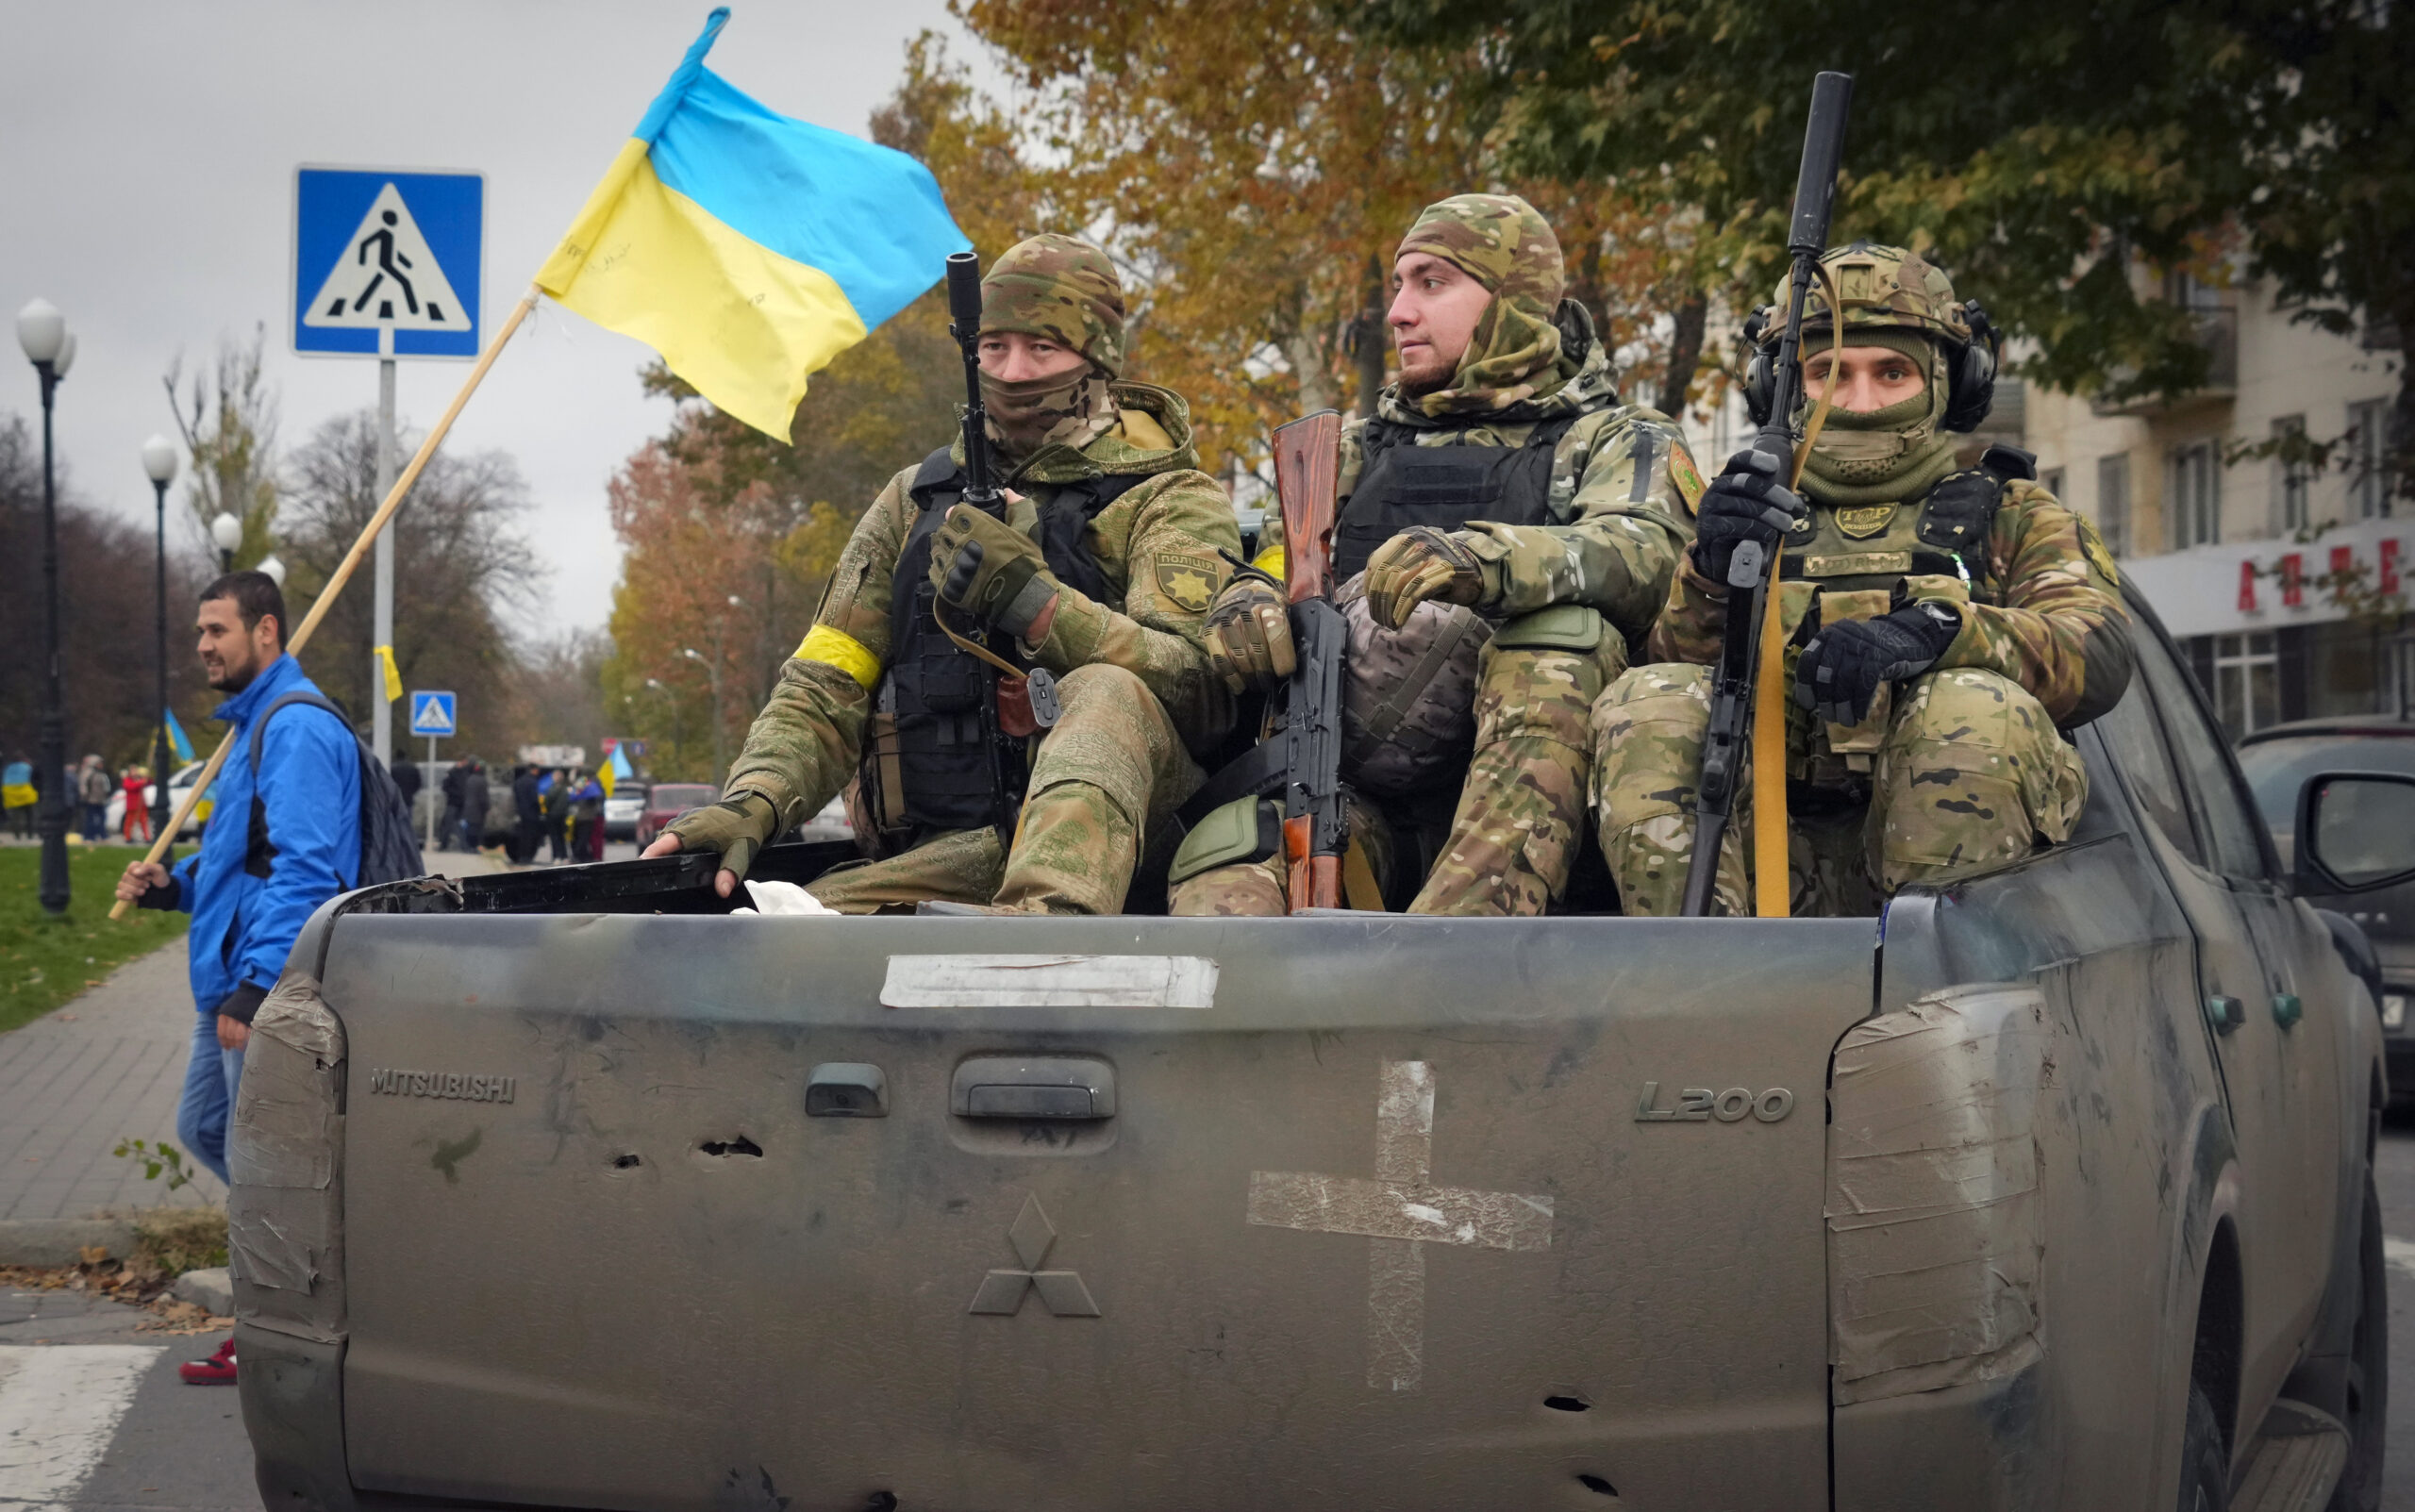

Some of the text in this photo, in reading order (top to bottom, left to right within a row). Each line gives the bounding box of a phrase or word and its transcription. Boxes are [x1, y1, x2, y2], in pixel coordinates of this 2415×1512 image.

[1161, 555, 1213, 571] ПОЛІЦІЯ
[371, 1068, 516, 1104] MITSUBISHI
[1634, 1081, 1793, 1122] L200
